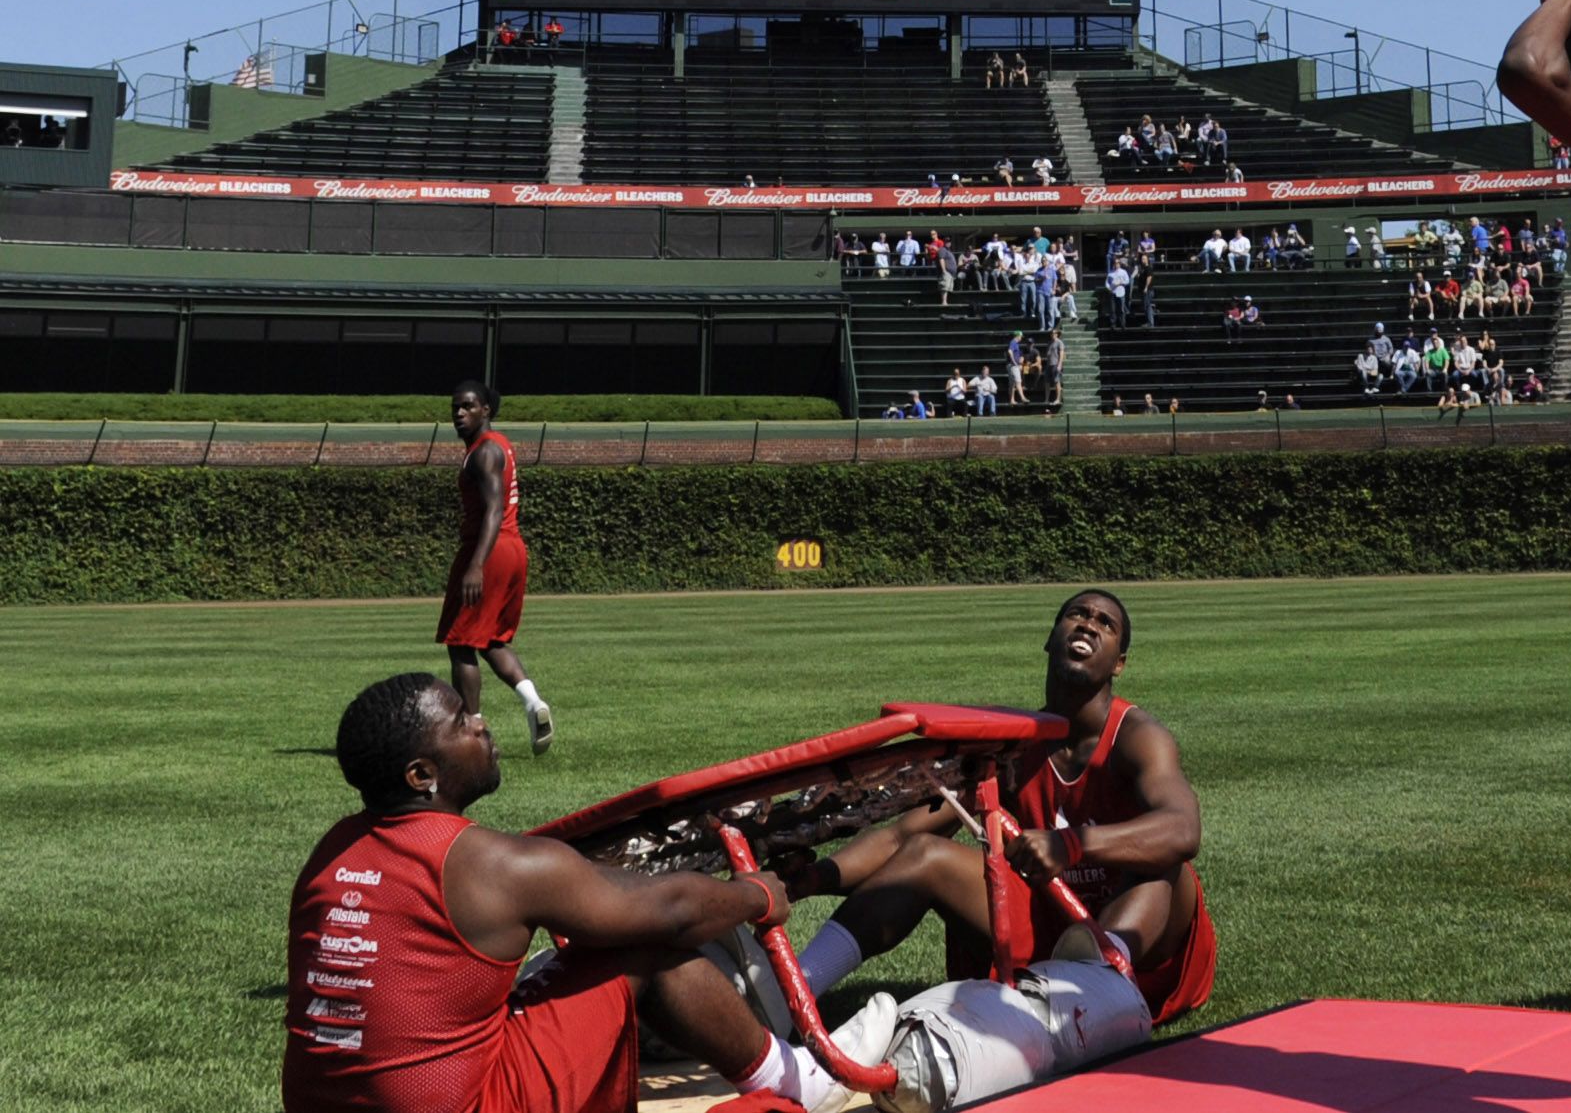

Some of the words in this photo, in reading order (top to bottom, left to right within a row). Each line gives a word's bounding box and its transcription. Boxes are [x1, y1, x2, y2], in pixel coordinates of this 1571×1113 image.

[111, 171, 216, 193] Budweiser
[219, 181, 291, 194] BLEACHERS
[314, 180, 417, 199] Budweiser
[421, 188, 490, 200] BLEACHERS
[512, 185, 612, 203] Budweiser
[615, 191, 683, 203] BLEACHERS
[704, 187, 803, 205] Budweiser
[806, 192, 873, 204] BLEACHERS
[994, 191, 1060, 202] BLEACHERS
[1080, 186, 1177, 205] Budweiser
[1180, 188, 1247, 200] BLEACHERS
[1267, 181, 1364, 199] Budweiser
[1367, 180, 1434, 193] BLEACHERS
[1455, 174, 1553, 193] Budweiser
[777, 542, 820, 567] 400
[335, 866, 382, 886] ComEd
[1063, 868, 1107, 884] MBLERS
[326, 907, 371, 924] Allstate
[320, 933, 378, 954] CUSTOM
